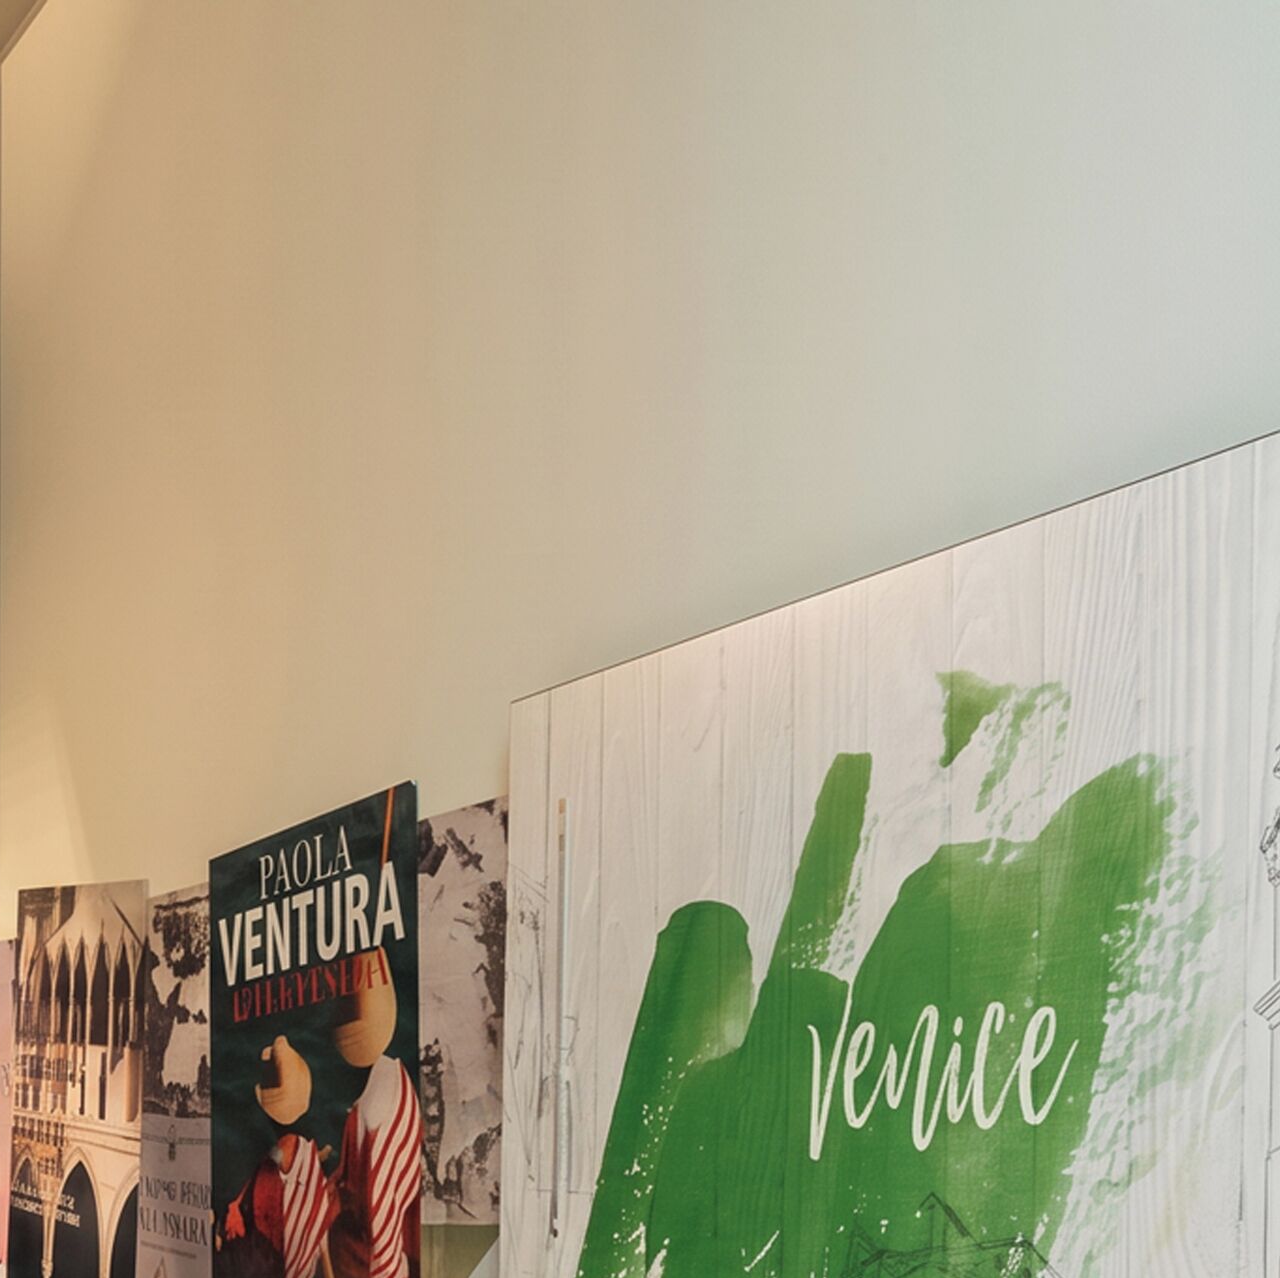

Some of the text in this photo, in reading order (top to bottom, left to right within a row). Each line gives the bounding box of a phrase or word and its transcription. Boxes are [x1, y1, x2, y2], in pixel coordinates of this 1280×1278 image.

[218, 860, 405, 987] VENTURA
[258, 825, 352, 900] PAOLA
[807, 984, 1079, 1161] Venice
